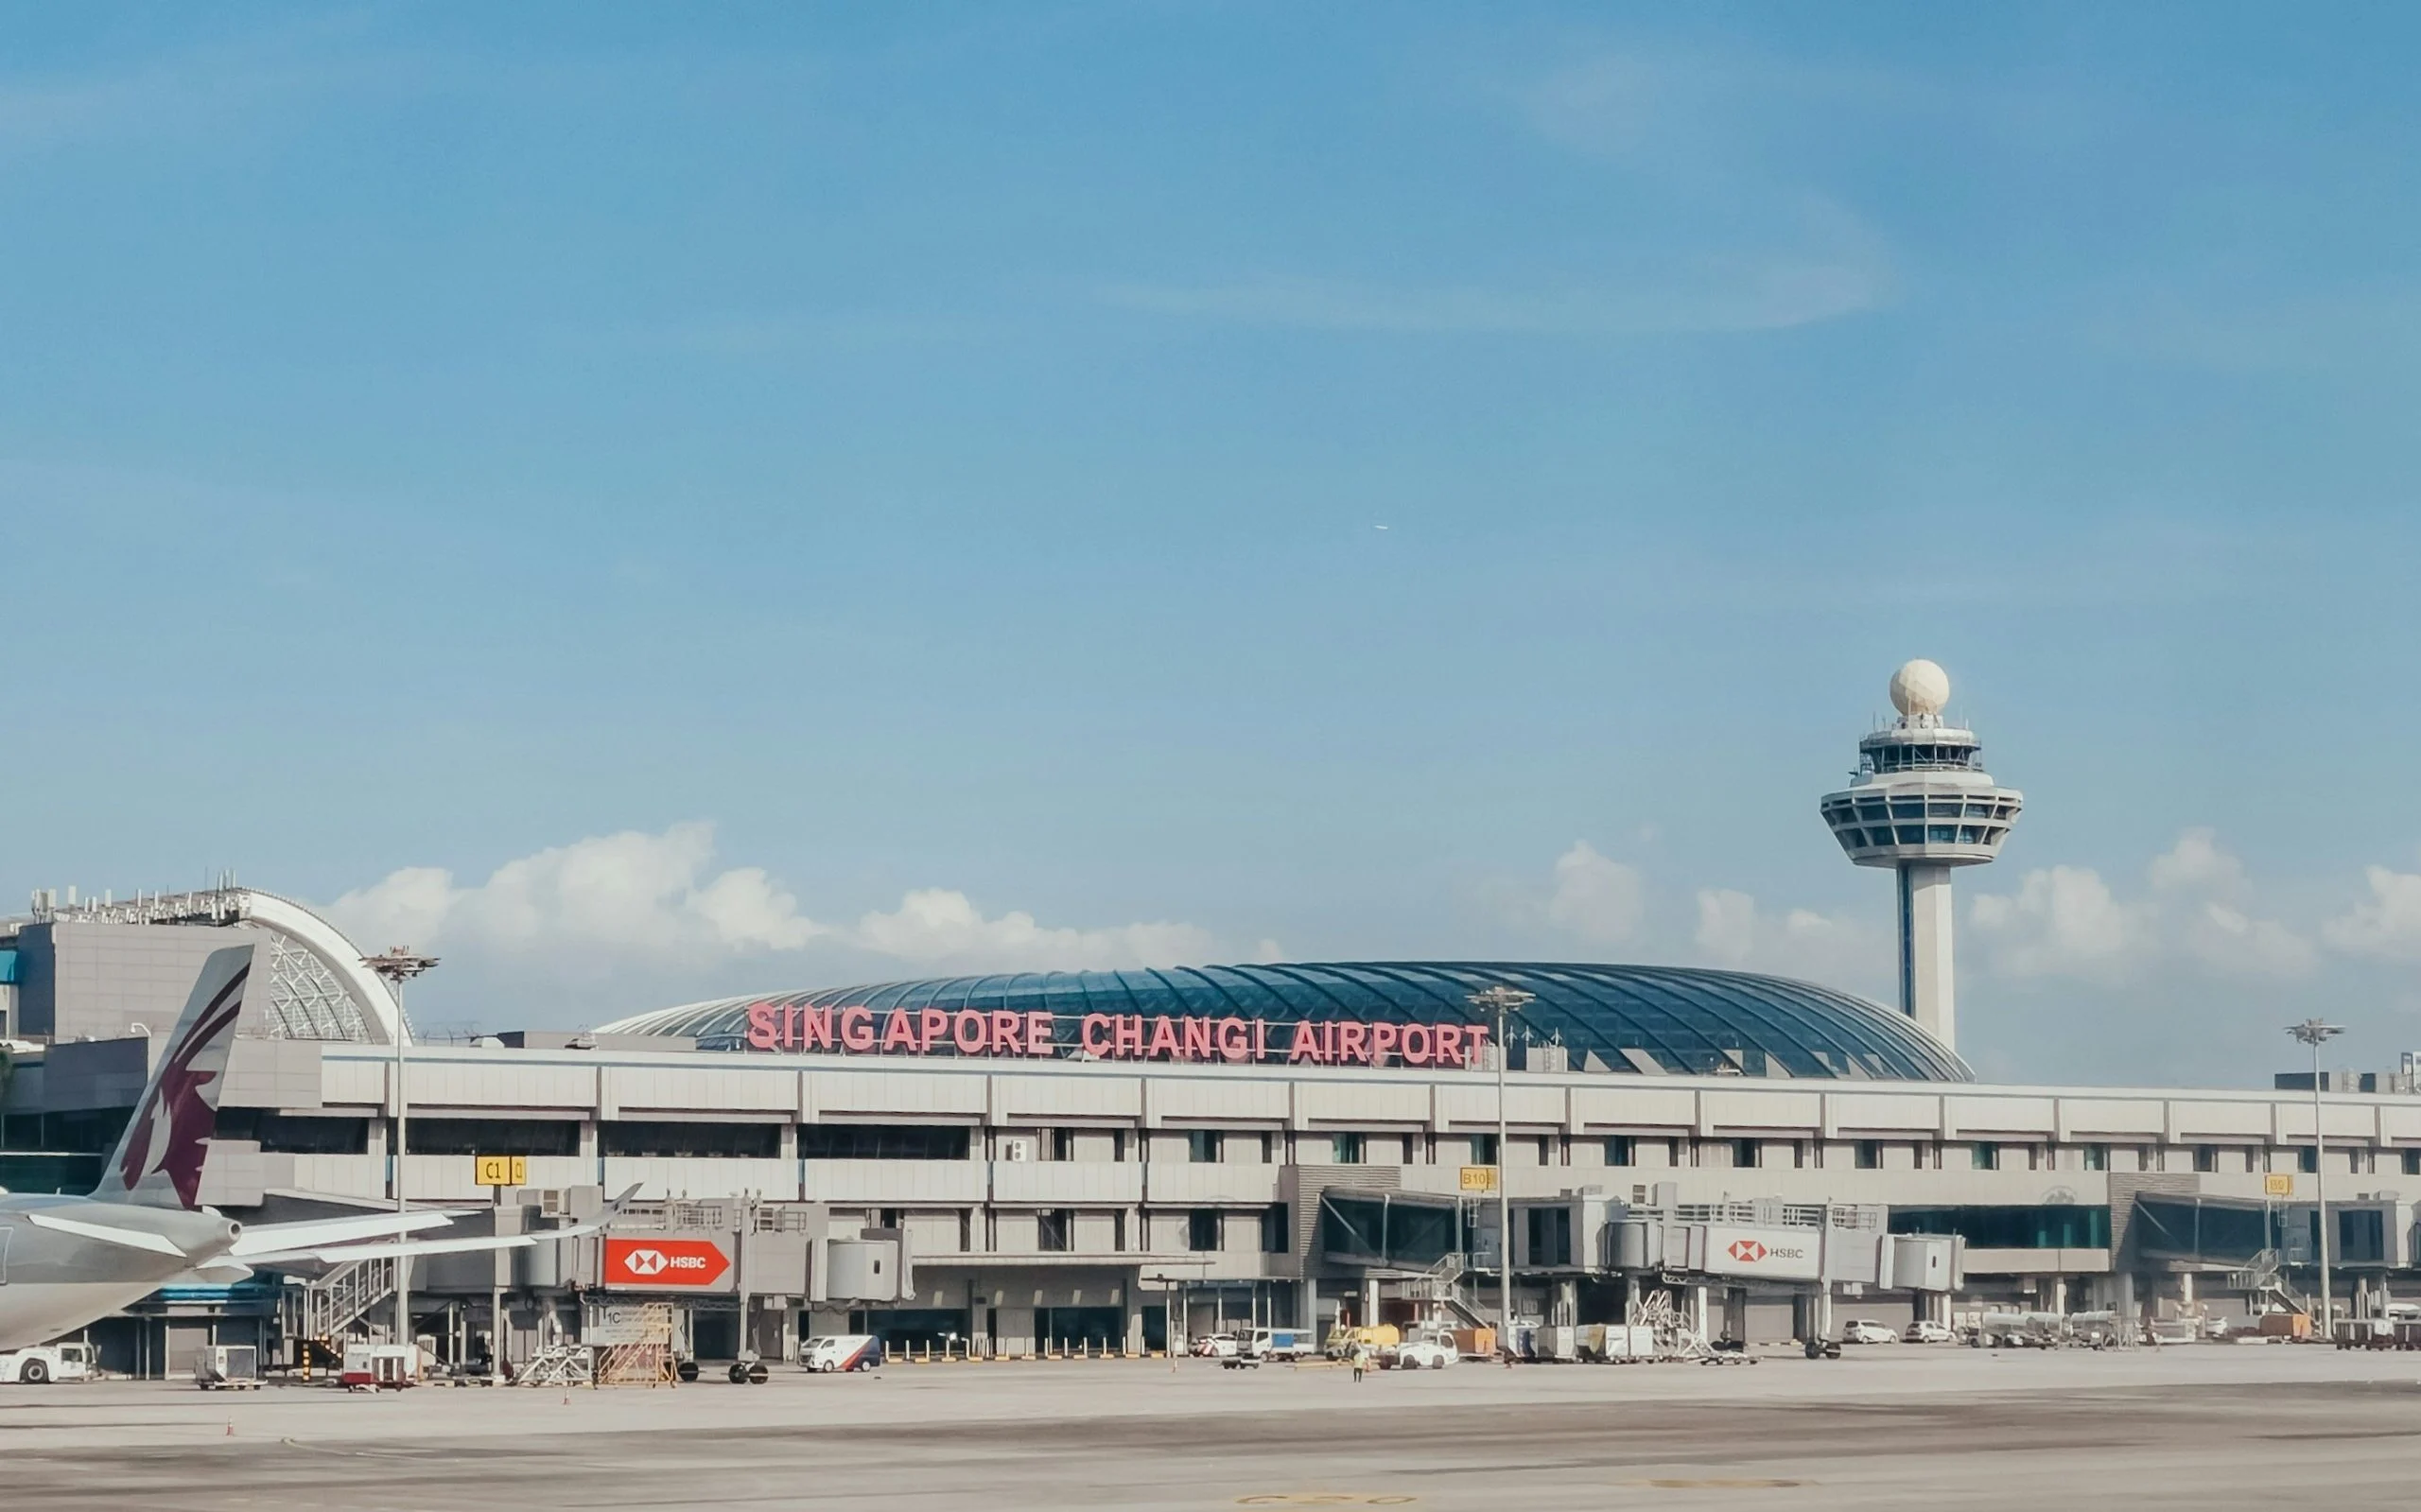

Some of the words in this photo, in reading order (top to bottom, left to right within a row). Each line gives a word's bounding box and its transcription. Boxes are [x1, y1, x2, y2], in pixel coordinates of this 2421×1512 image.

[745, 1003, 1054, 1054] SINGAPORE
[1082, 1013, 1266, 1059] CHANGI
[1290, 1019, 1489, 1065] AIRPORT
[486, 1162, 501, 1179] C1
[1463, 1173, 1486, 1184] B10
[1769, 1248, 1803, 1260] HSBC
[670, 1256, 706, 1269] HSBC
